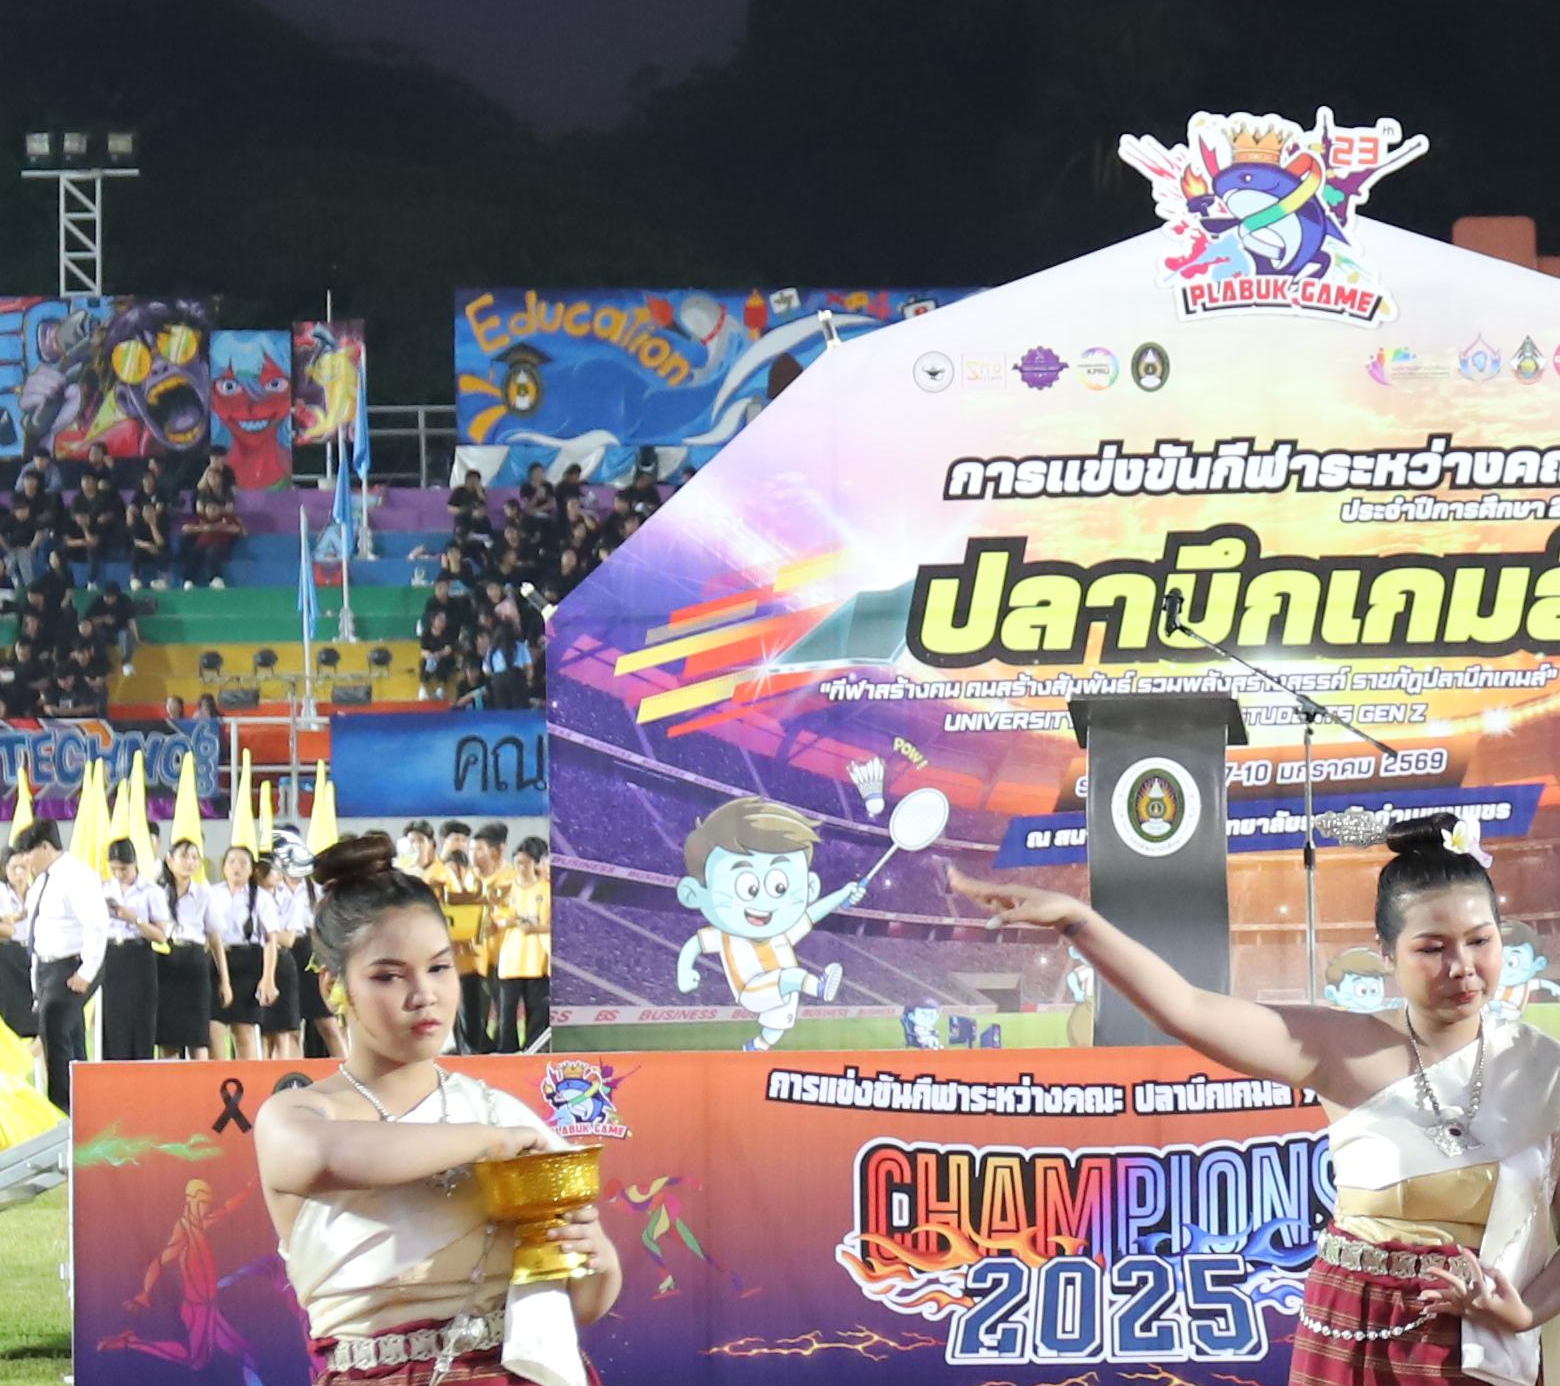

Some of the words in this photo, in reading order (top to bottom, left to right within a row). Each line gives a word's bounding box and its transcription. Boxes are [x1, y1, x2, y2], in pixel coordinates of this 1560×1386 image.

[1332, 136, 1379, 166] 23
[1190, 279, 1288, 306] PLABUK
[1301, 280, 1375, 314] GAME
[465, 290, 695, 387] Education
[1341, 493, 1546, 523] ประจำปีการศึกษา
[1358, 704, 1408, 725] GEN
[1409, 703, 1428, 723] Z
[1277, 755, 1374, 783] มกราคม
[1380, 749, 1448, 776] 2569
[638, 1008, 718, 1022] BUSINESS
[768, 1066, 1125, 1114] การแข่งขันกีฬาระหว่างคณะ
[1133, 1074, 1293, 1114] ปลาบึกเกมส
[948, 1255, 1268, 1362] 2025
